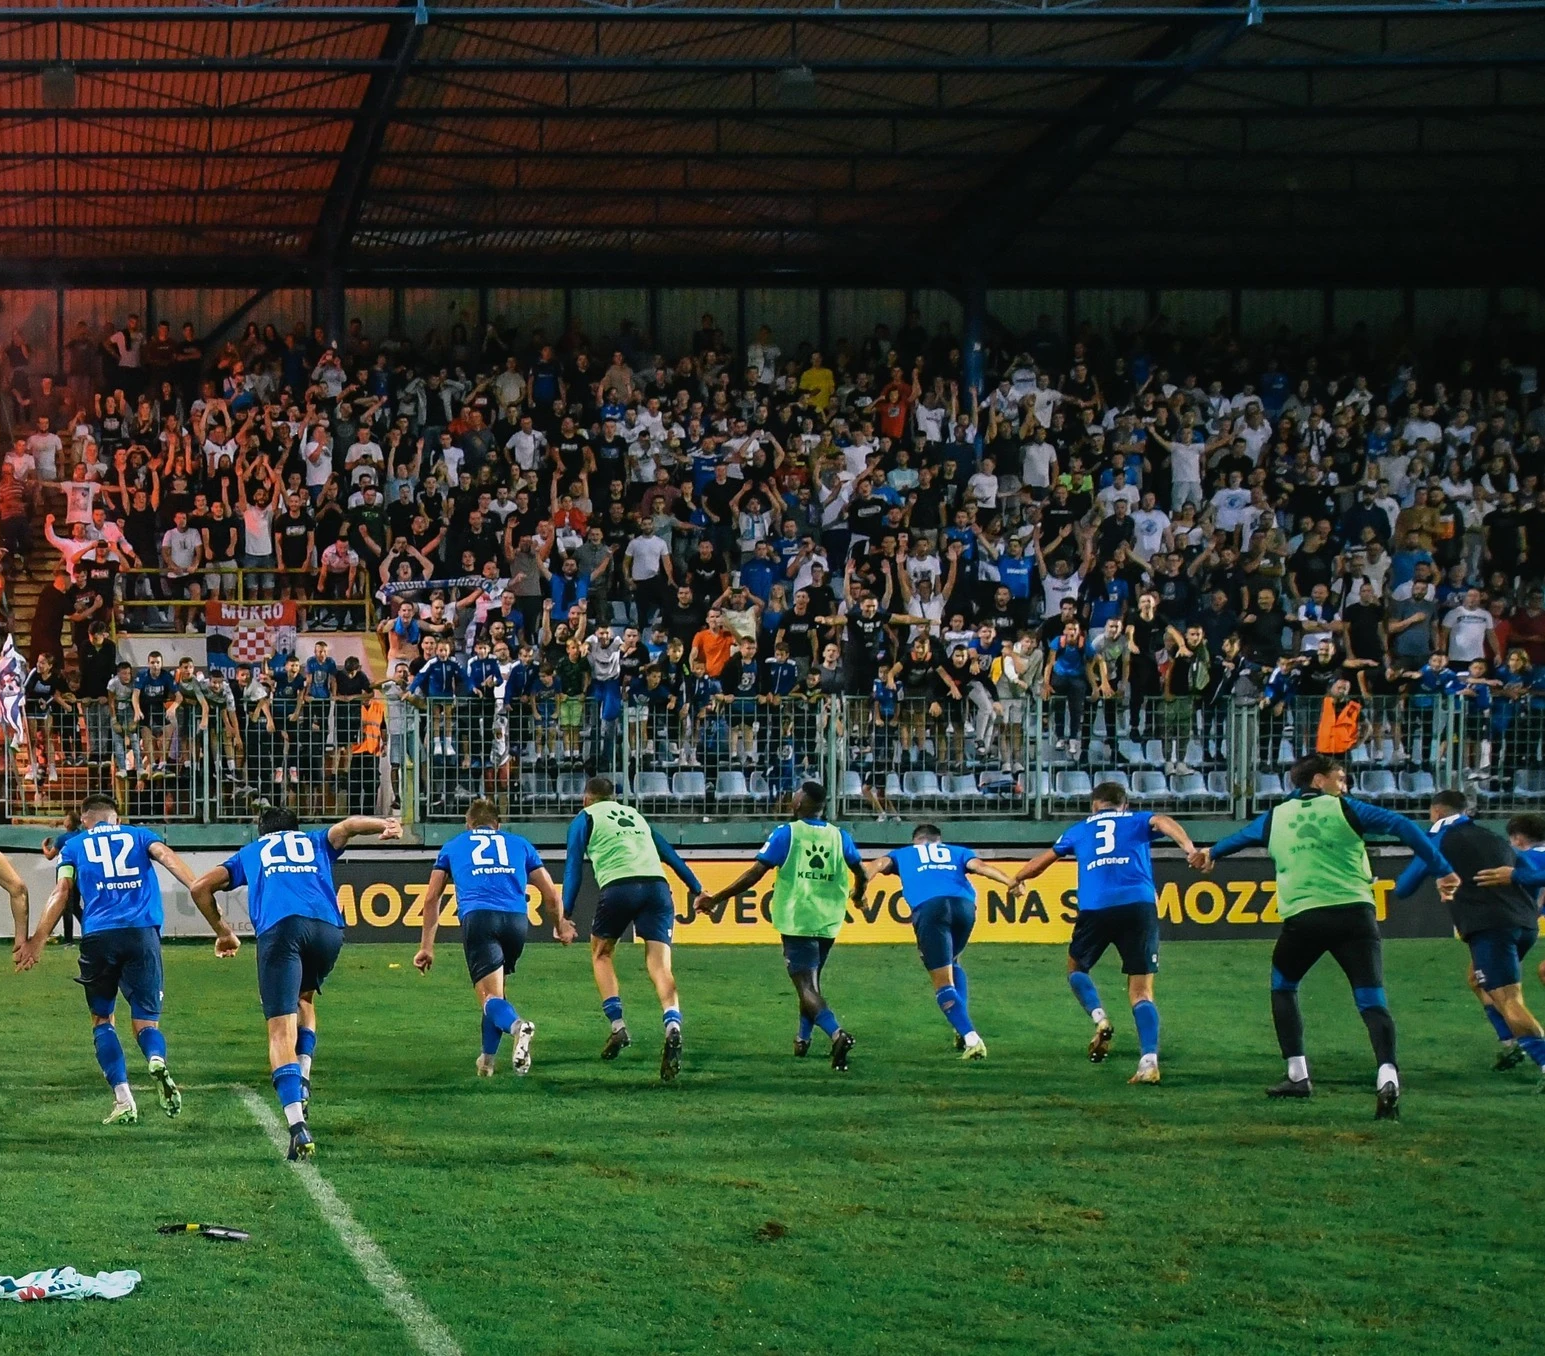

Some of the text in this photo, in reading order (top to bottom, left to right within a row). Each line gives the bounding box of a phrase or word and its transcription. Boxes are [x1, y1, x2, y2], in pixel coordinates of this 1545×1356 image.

[258, 830, 316, 868] 26
[469, 834, 509, 866] 21
[913, 842, 952, 864] 16
[1095, 819, 1116, 855] 3
[83, 833, 140, 878] 42
[797, 871, 835, 881] KELME
[987, 890, 1050, 923] NA
